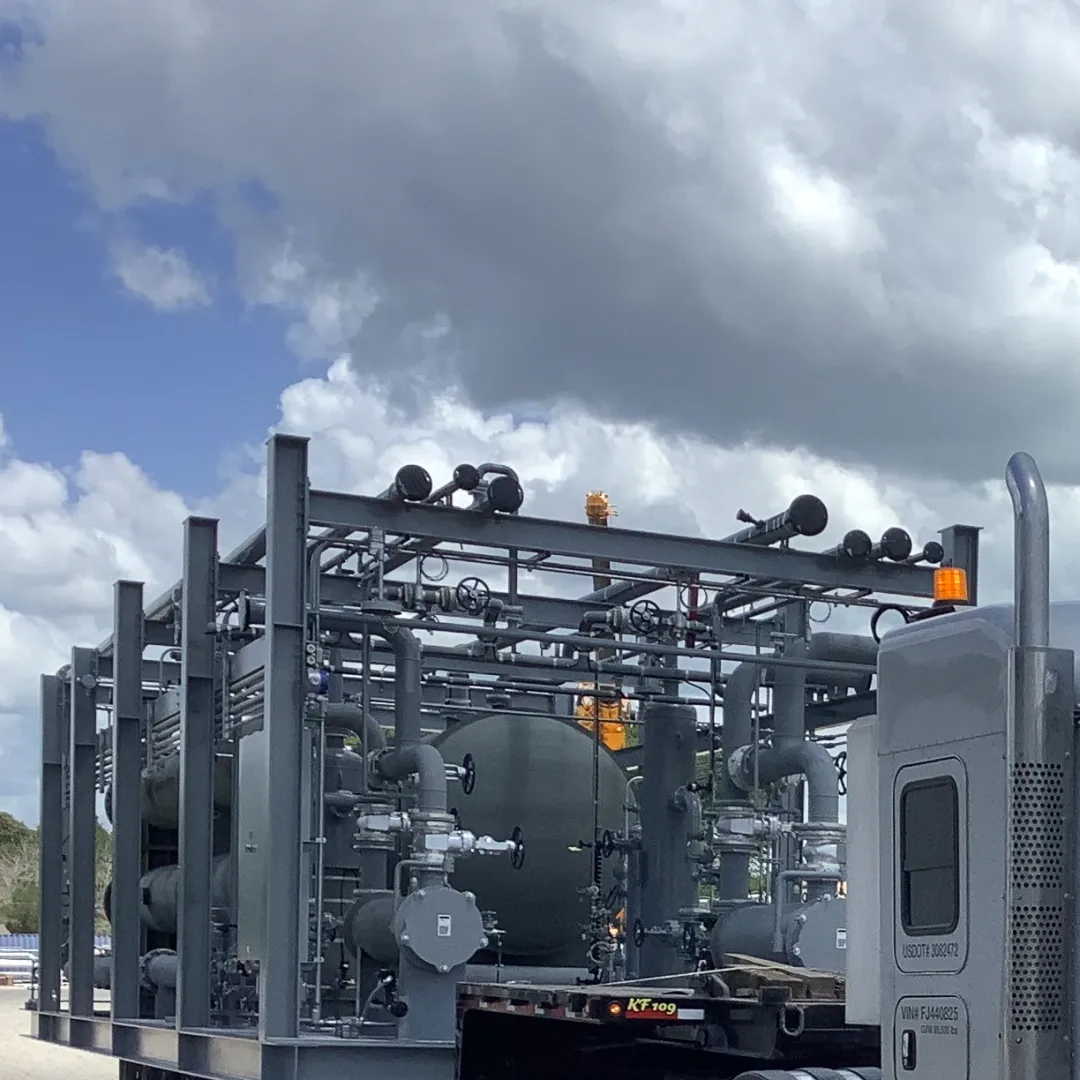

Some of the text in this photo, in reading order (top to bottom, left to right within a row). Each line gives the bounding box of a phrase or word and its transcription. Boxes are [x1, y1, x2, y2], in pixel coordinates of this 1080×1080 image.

[902, 944, 930, 959] USDOT#
[627, 998, 677, 1015] KF 109
[901, 1006, 919, 1020] VIN#
